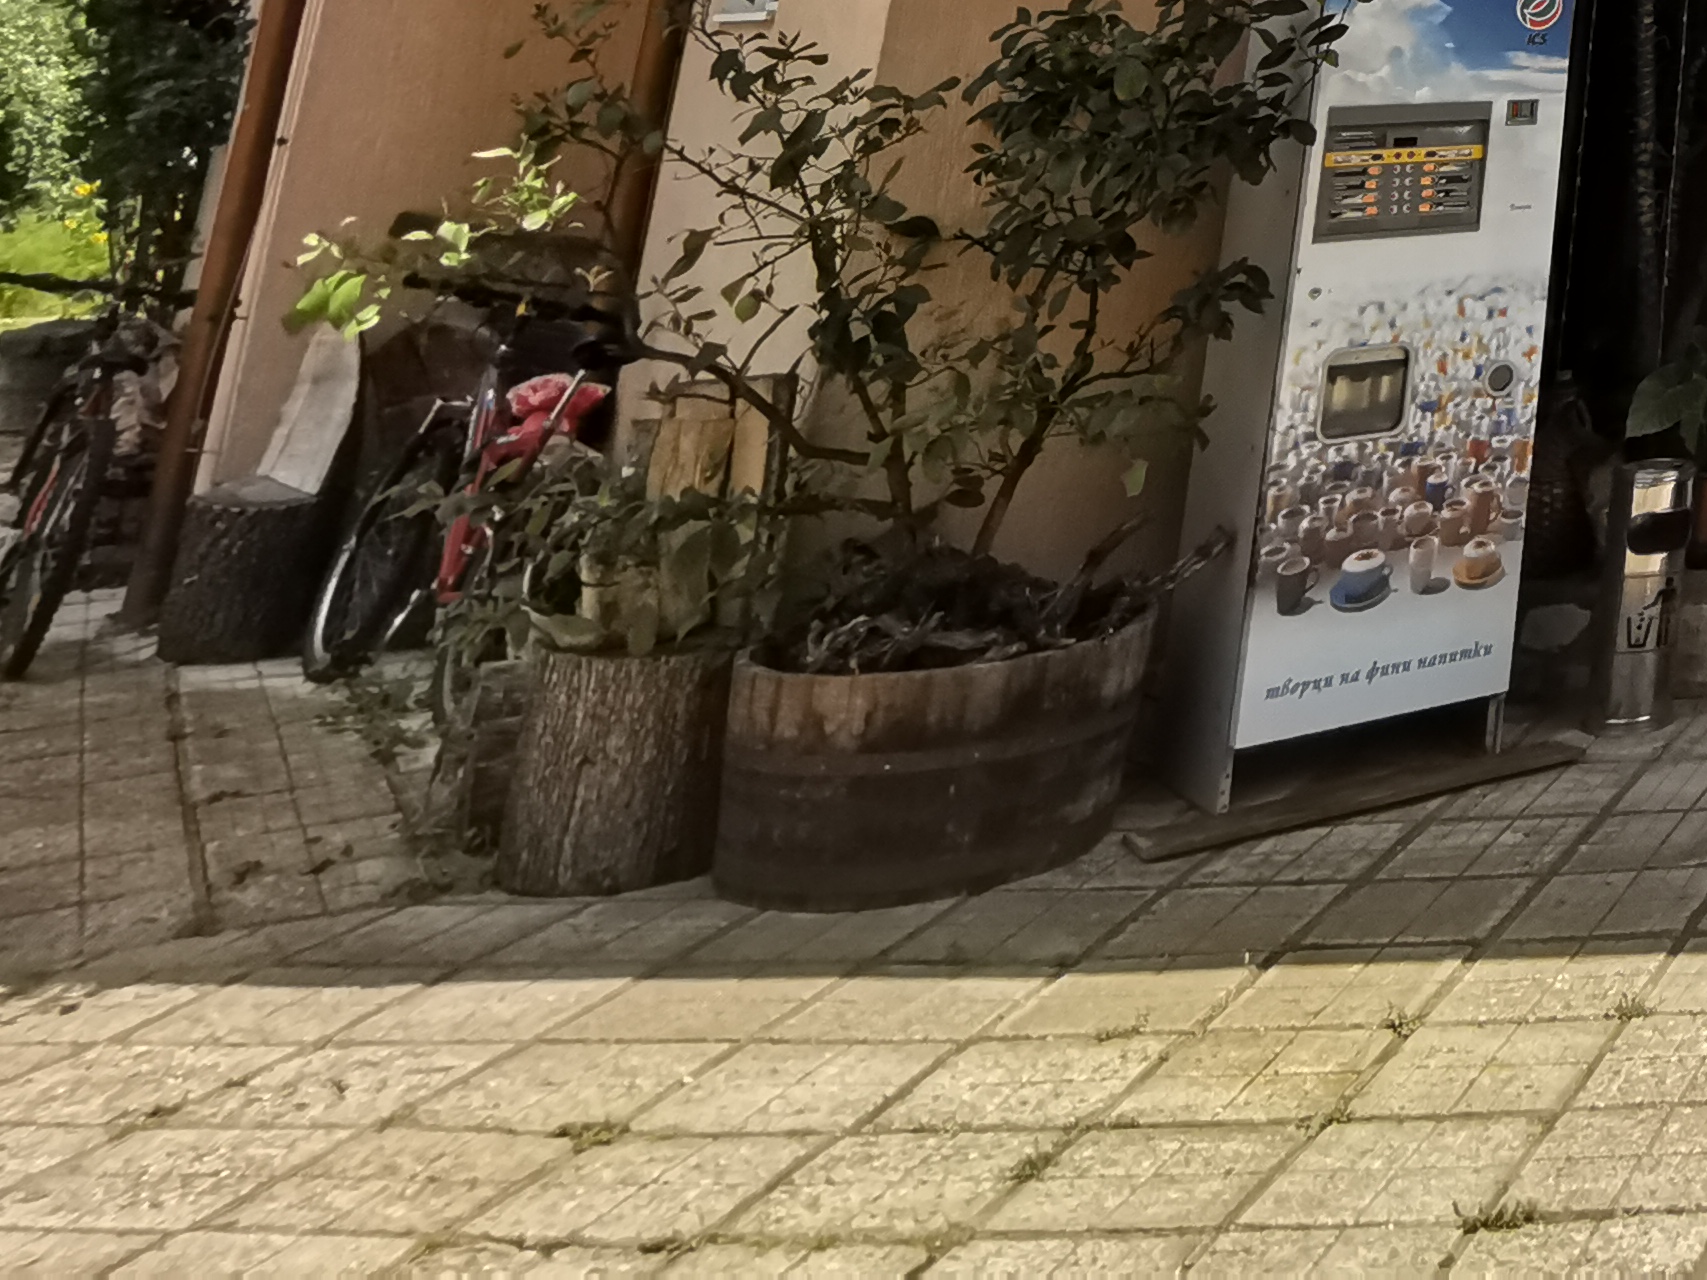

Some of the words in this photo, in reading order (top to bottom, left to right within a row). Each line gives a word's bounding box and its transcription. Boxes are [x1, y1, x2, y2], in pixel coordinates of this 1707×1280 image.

[1339, 668, 1362, 687] на
[1364, 659, 1414, 686] фини
[1416, 640, 1494, 671] напитки
